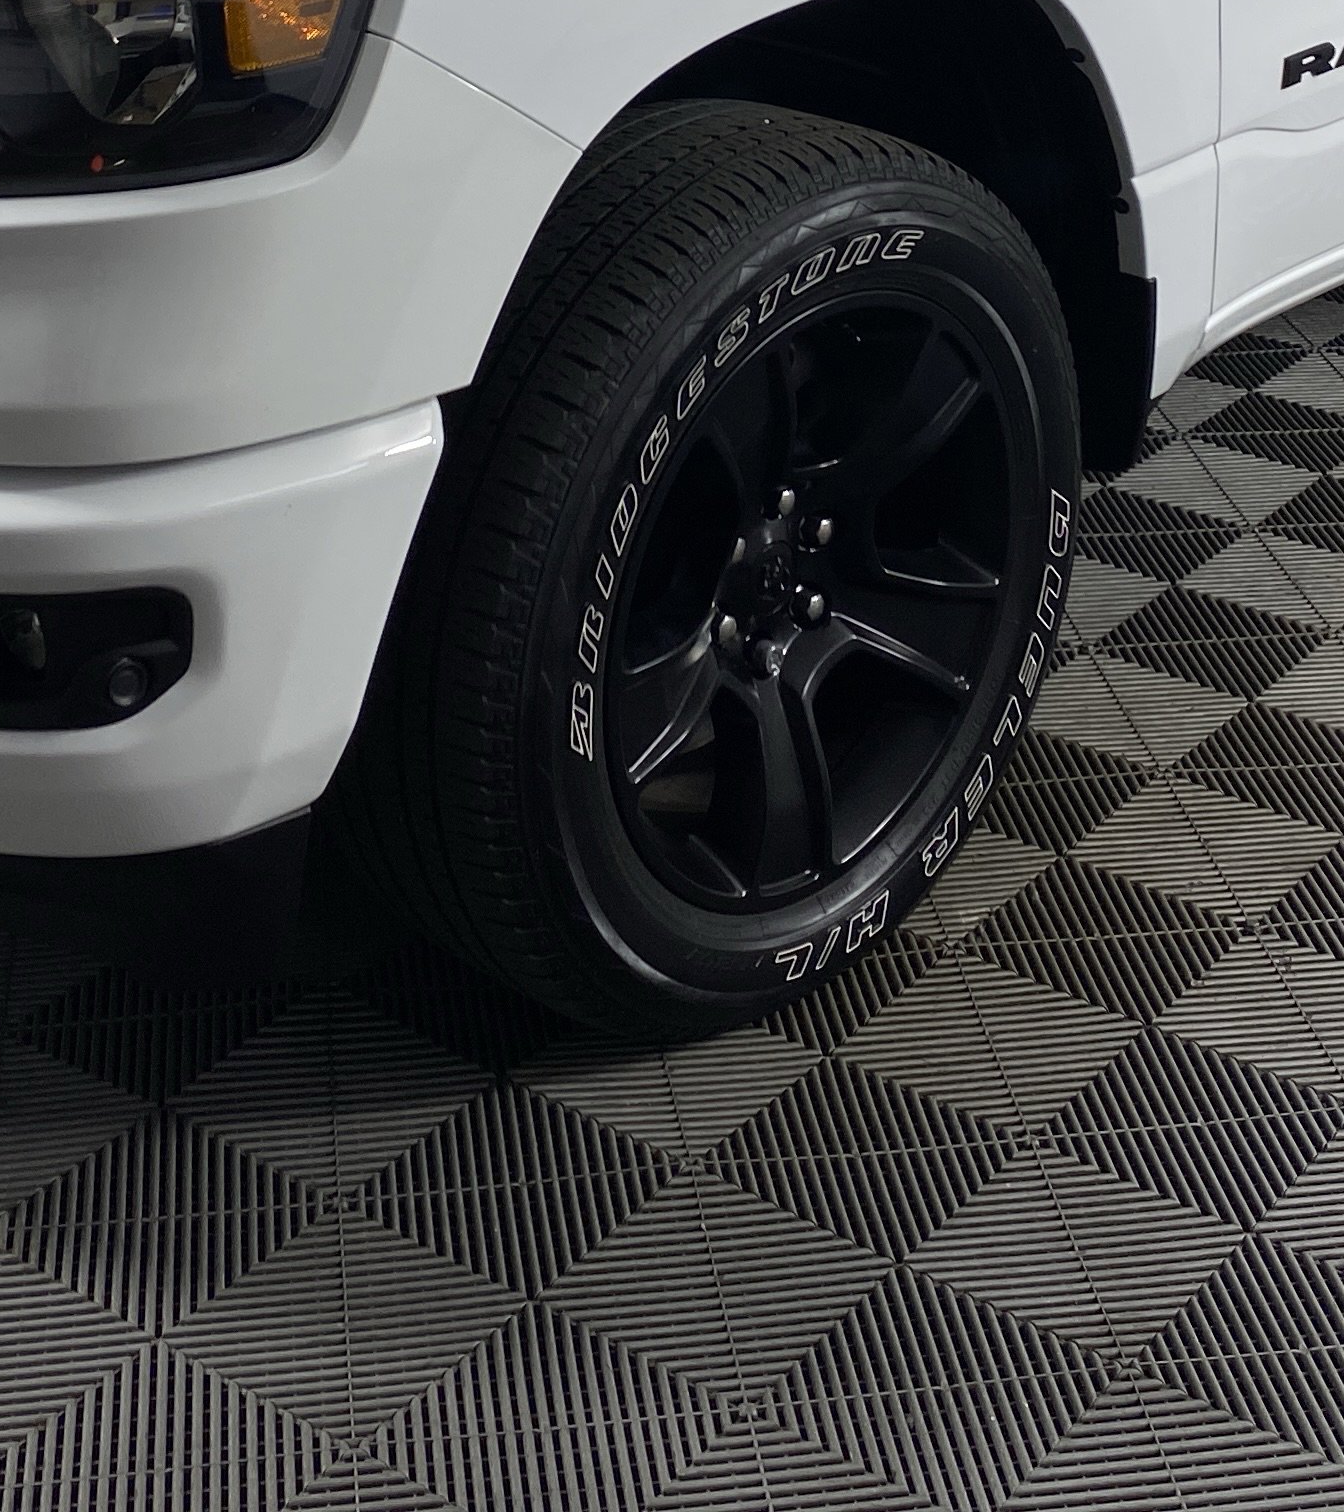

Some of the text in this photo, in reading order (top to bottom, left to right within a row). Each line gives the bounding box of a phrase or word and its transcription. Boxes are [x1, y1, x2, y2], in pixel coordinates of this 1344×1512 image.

[570, 228, 925, 762] BRIDGESTONE
[774, 488, 1071, 981] DUELER H/L
